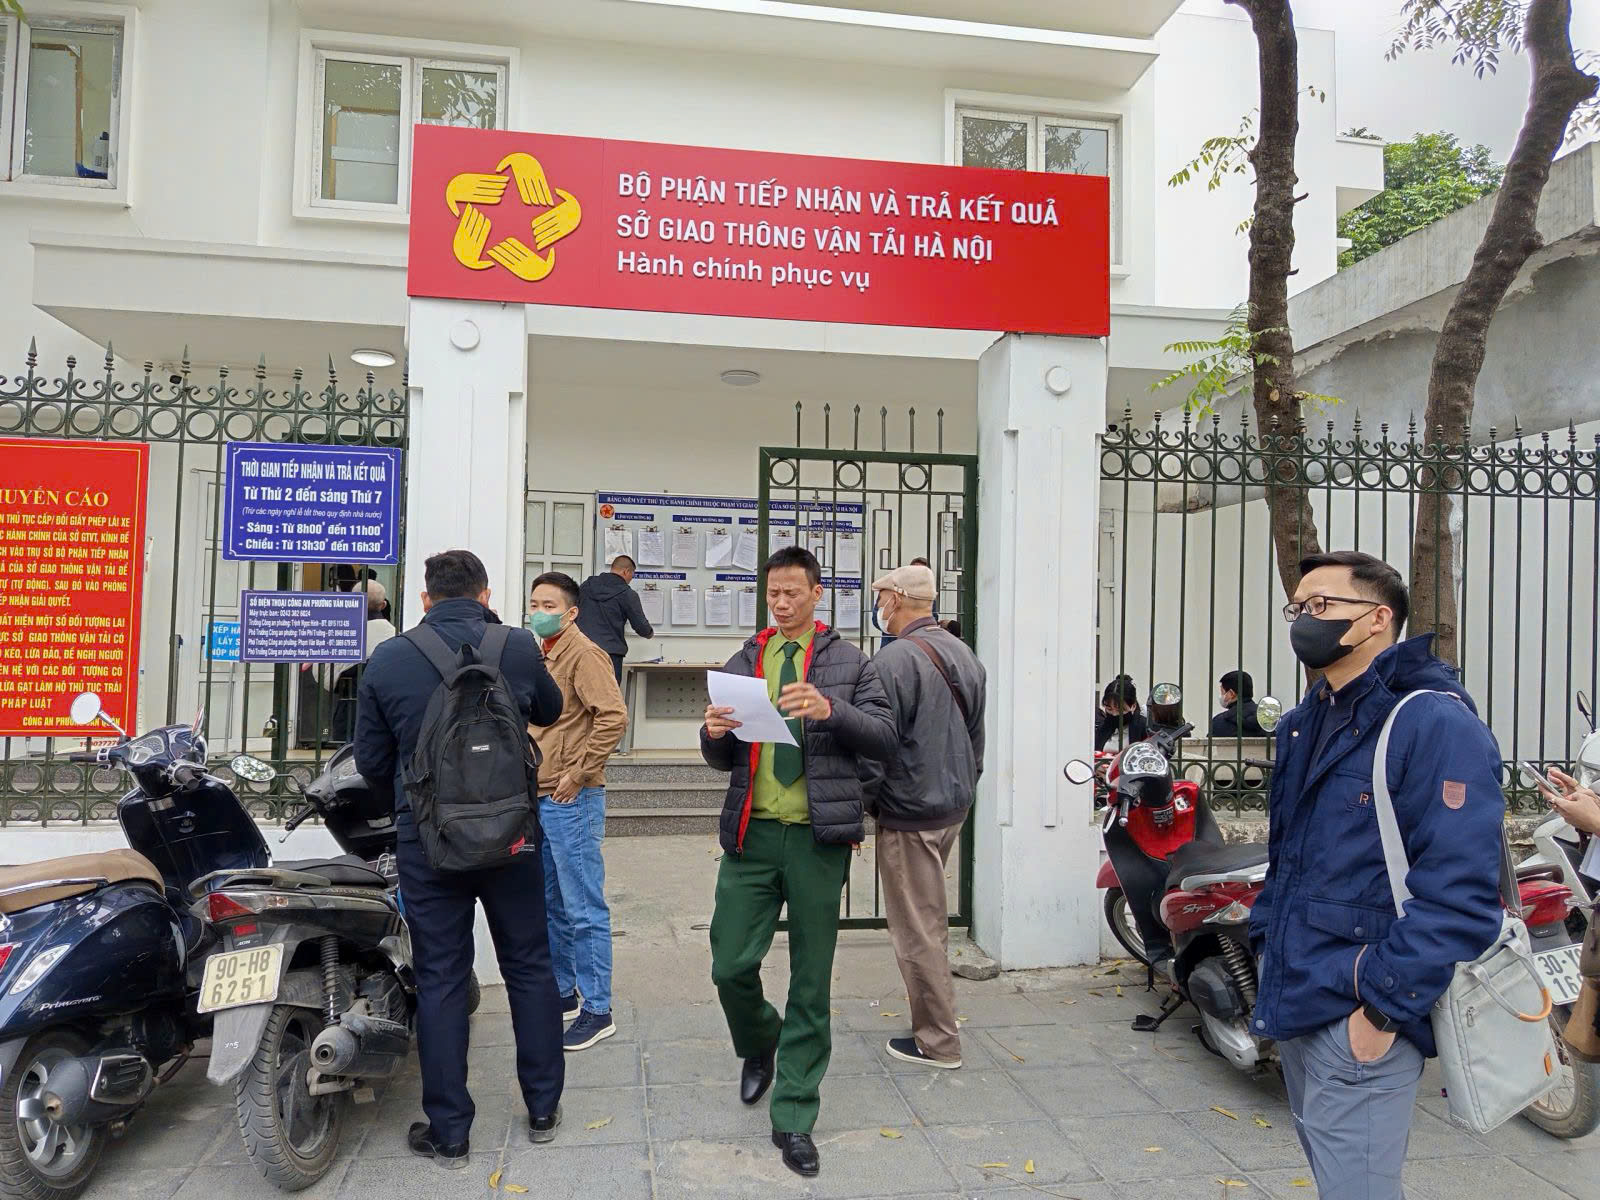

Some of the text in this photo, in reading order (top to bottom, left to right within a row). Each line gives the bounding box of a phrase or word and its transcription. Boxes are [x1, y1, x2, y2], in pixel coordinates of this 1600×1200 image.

[619, 171, 1059, 226] BỘ PHẬN TIẾP NHẬN VÀ TRẢ KẾT QUẢ
[617, 210, 993, 265] SỞ GIAO THÔNG VẬN TẢI HÀ NỘI
[618, 251, 870, 294] Hành chính phục vụ
[241, 460, 386, 482] THỜI GIAN TIẾP NHẬN VÀ TRẢ KẾT QUẢ
[66, 488, 109, 507] CÁO
[244, 486, 383, 504] Từ Thứ 2 đến sáng Thứ 7
[7, 511, 20, 525] THỦ
[22, 512, 35, 526] TỤC
[88, 513, 106, 527] PHÉP
[108, 514, 119, 528] LÁI
[121, 514, 130, 528] XE
[6, 528, 26, 541] HÀNH
[28, 529, 50, 542] CHÍNH
[53, 530, 67, 542] CỦA
[69, 530, 79, 543] SỞ
[247, 522, 273, 534] Sáng
[282, 523, 295, 533] Từ
[328, 524, 346, 535] đến
[245, 538, 274, 550] Chiều
[282, 540, 294, 550] Từ
[331, 540, 349, 551] đến
[10, 545, 24, 558] VÀO
[27, 546, 40, 559] TRỤ
[43, 546, 53, 559] SỞ
[56, 546, 66, 559] BỘ
[68, 546, 88, 560] PHẬN
[91, 547, 106, 560] TIẾP
[109, 547, 129, 561] NHẬN
[9, 561, 23, 574] CỦA
[27, 561, 37, 574] SỞ
[40, 561, 57, 575] GIAO
[60, 562, 83, 575] THÔNG
[87, 562, 101, 575] VẬN
[104, 562, 115, 576] TẢI
[55, 578, 69, 591] SAU
[85, 578, 99, 592] VÀO
[103, 578, 128, 592] PHÒNG
[9, 594, 29, 606] NHẬN
[31, 594, 46, 607] GIẢI
[302, 599, 311, 607] AN
[14, 613, 34, 626] HIỆN
[36, 613, 53, 627] MỘT
[55, 614, 66, 627] SỐ
[12, 629, 23, 642] SỞ
[28, 630, 48, 643] GIAO
[50, 630, 77, 643] THÔNG
[79, 630, 96, 644] VẬN
[99, 631, 110, 644] TẢI
[76, 647, 96, 661] NGHỊ
[42, 664, 59, 677] CÁC
[35, 681, 53, 694] LÀM
[69, 682, 84, 694] THỦ
[104, 682, 122, 694] TRÁI
[1, 697, 52, 710] PHÁP LUẬT
[44, 715, 55, 726] AN
[216, 950, 271, 980] 90-H8
[211, 975, 267, 1005] 6251
[1553, 973, 1583, 998] 16
